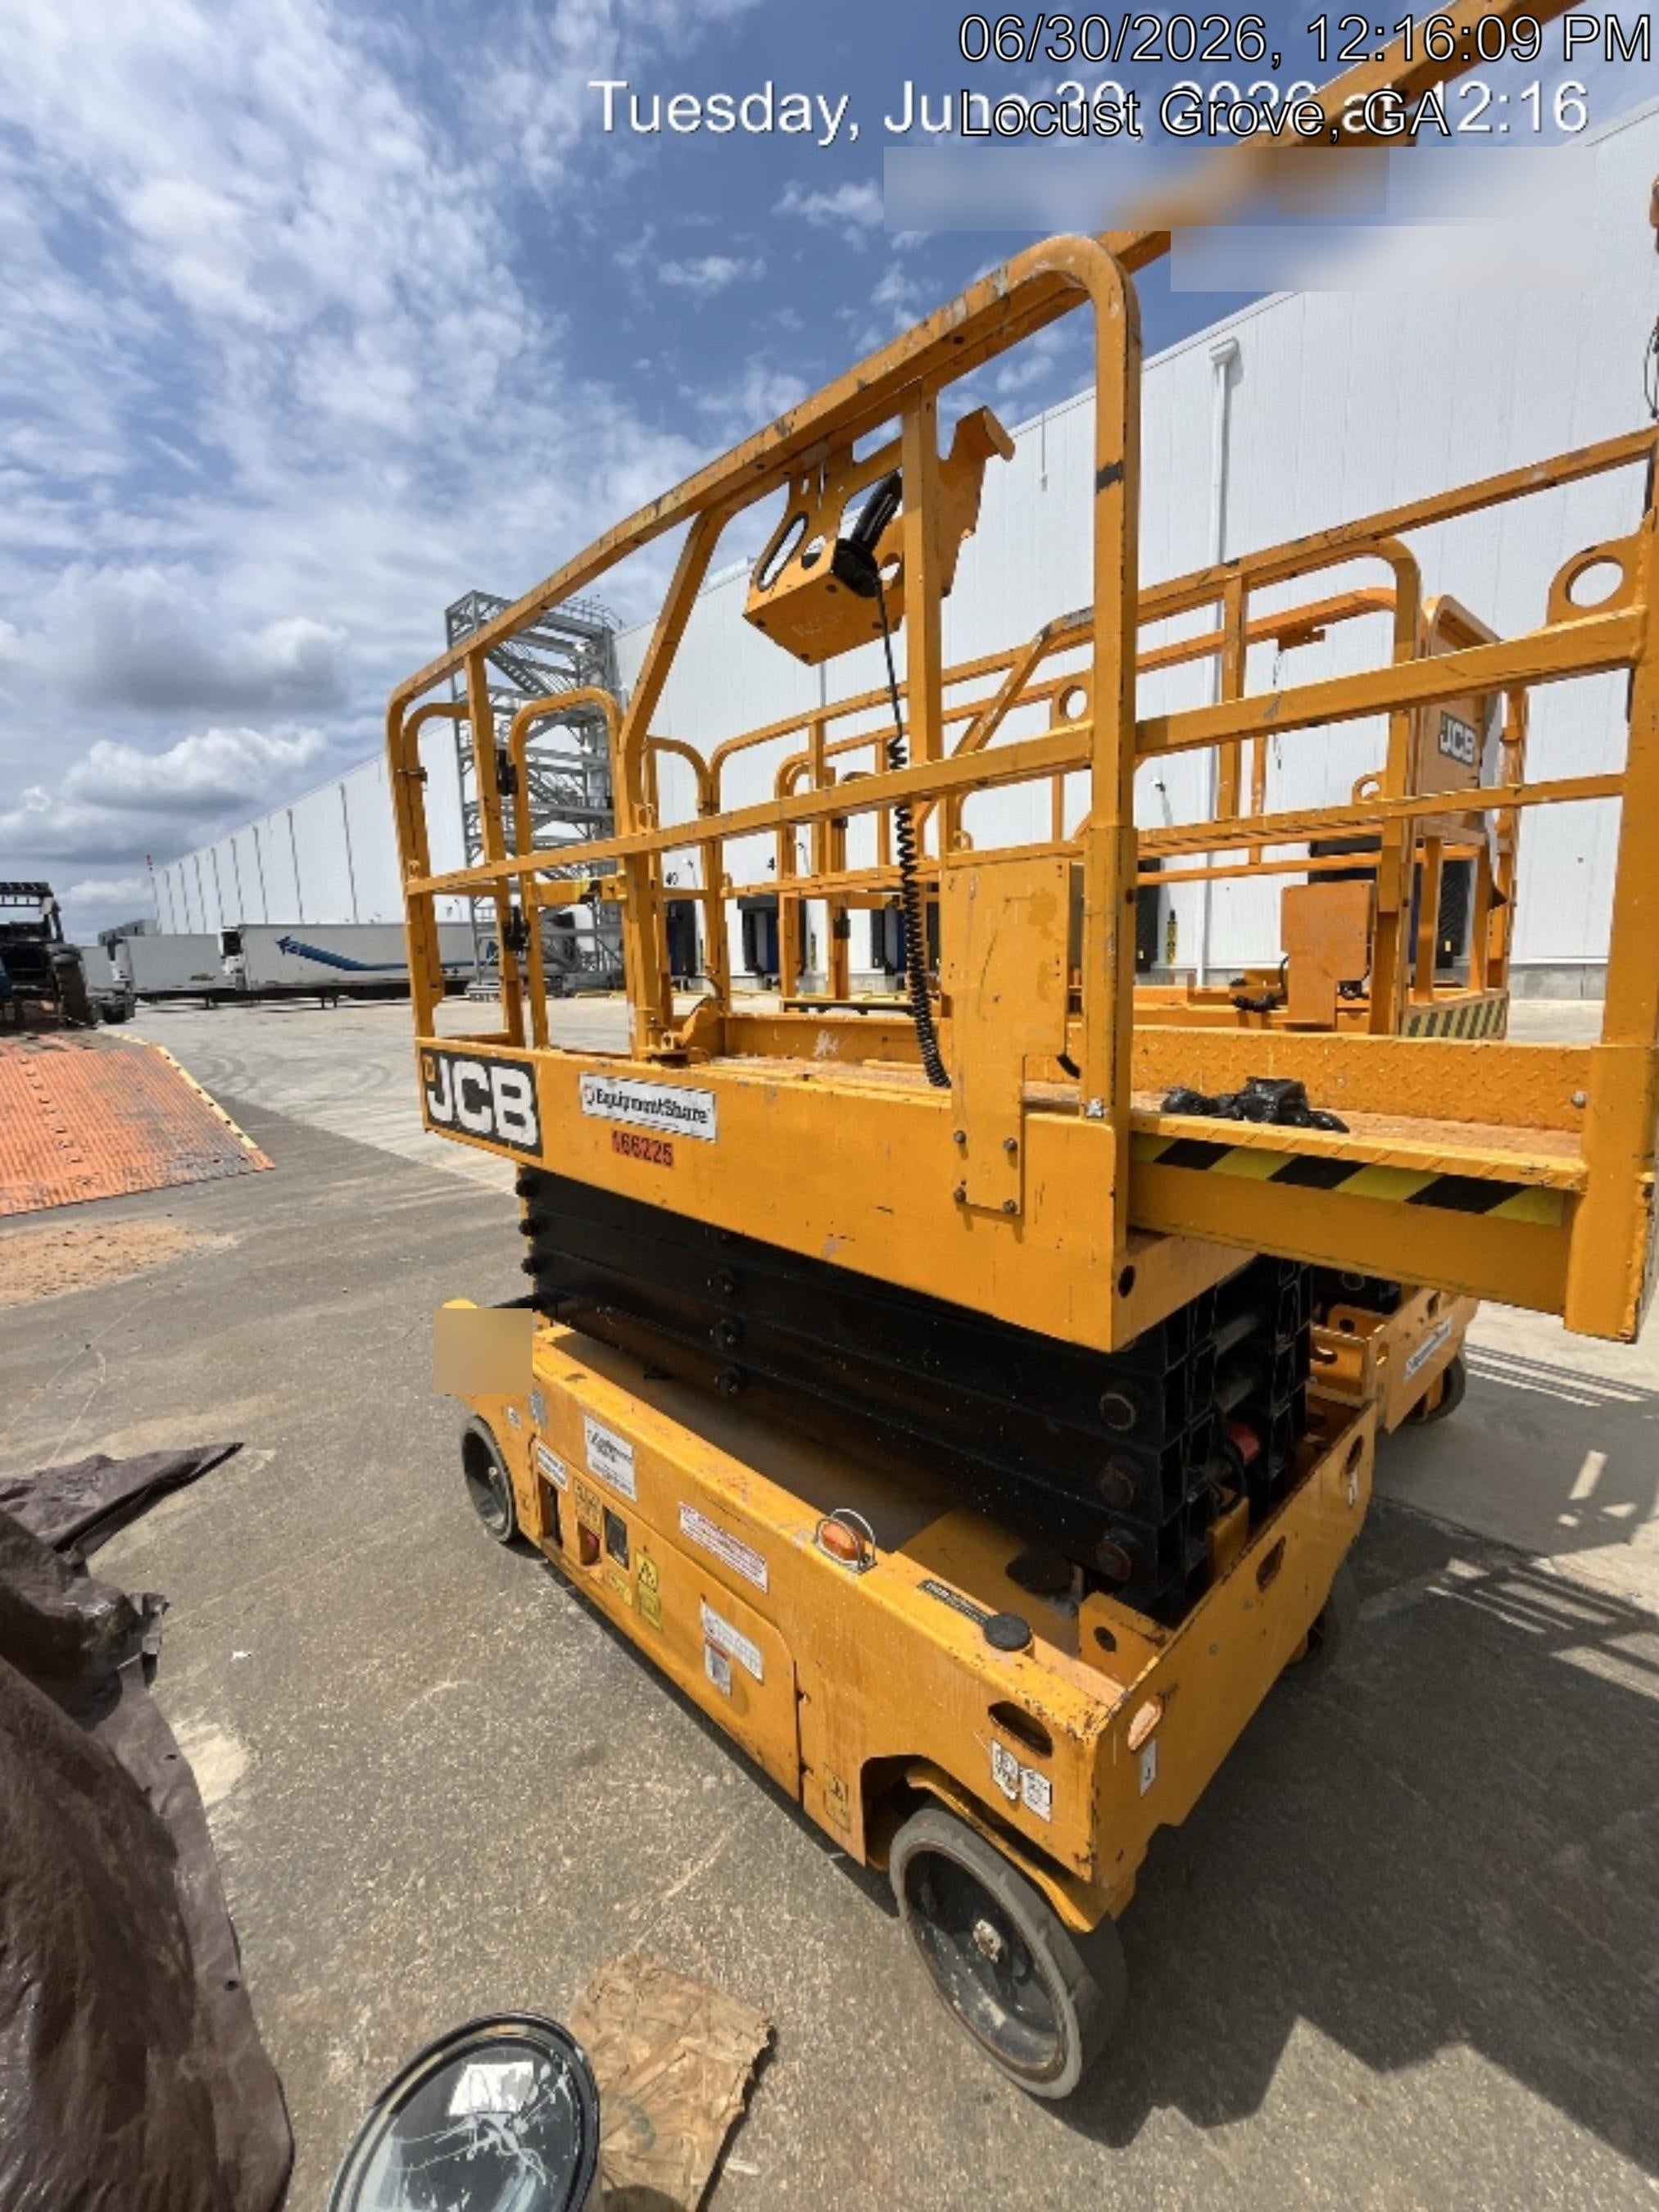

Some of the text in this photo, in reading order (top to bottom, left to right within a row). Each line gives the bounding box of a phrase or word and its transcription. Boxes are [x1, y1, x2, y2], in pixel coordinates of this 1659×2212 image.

[1439, 719, 1475, 764] JCB
[427, 1055, 539, 1146] JCB
[596, 1087, 709, 1125] EquipmentShare
